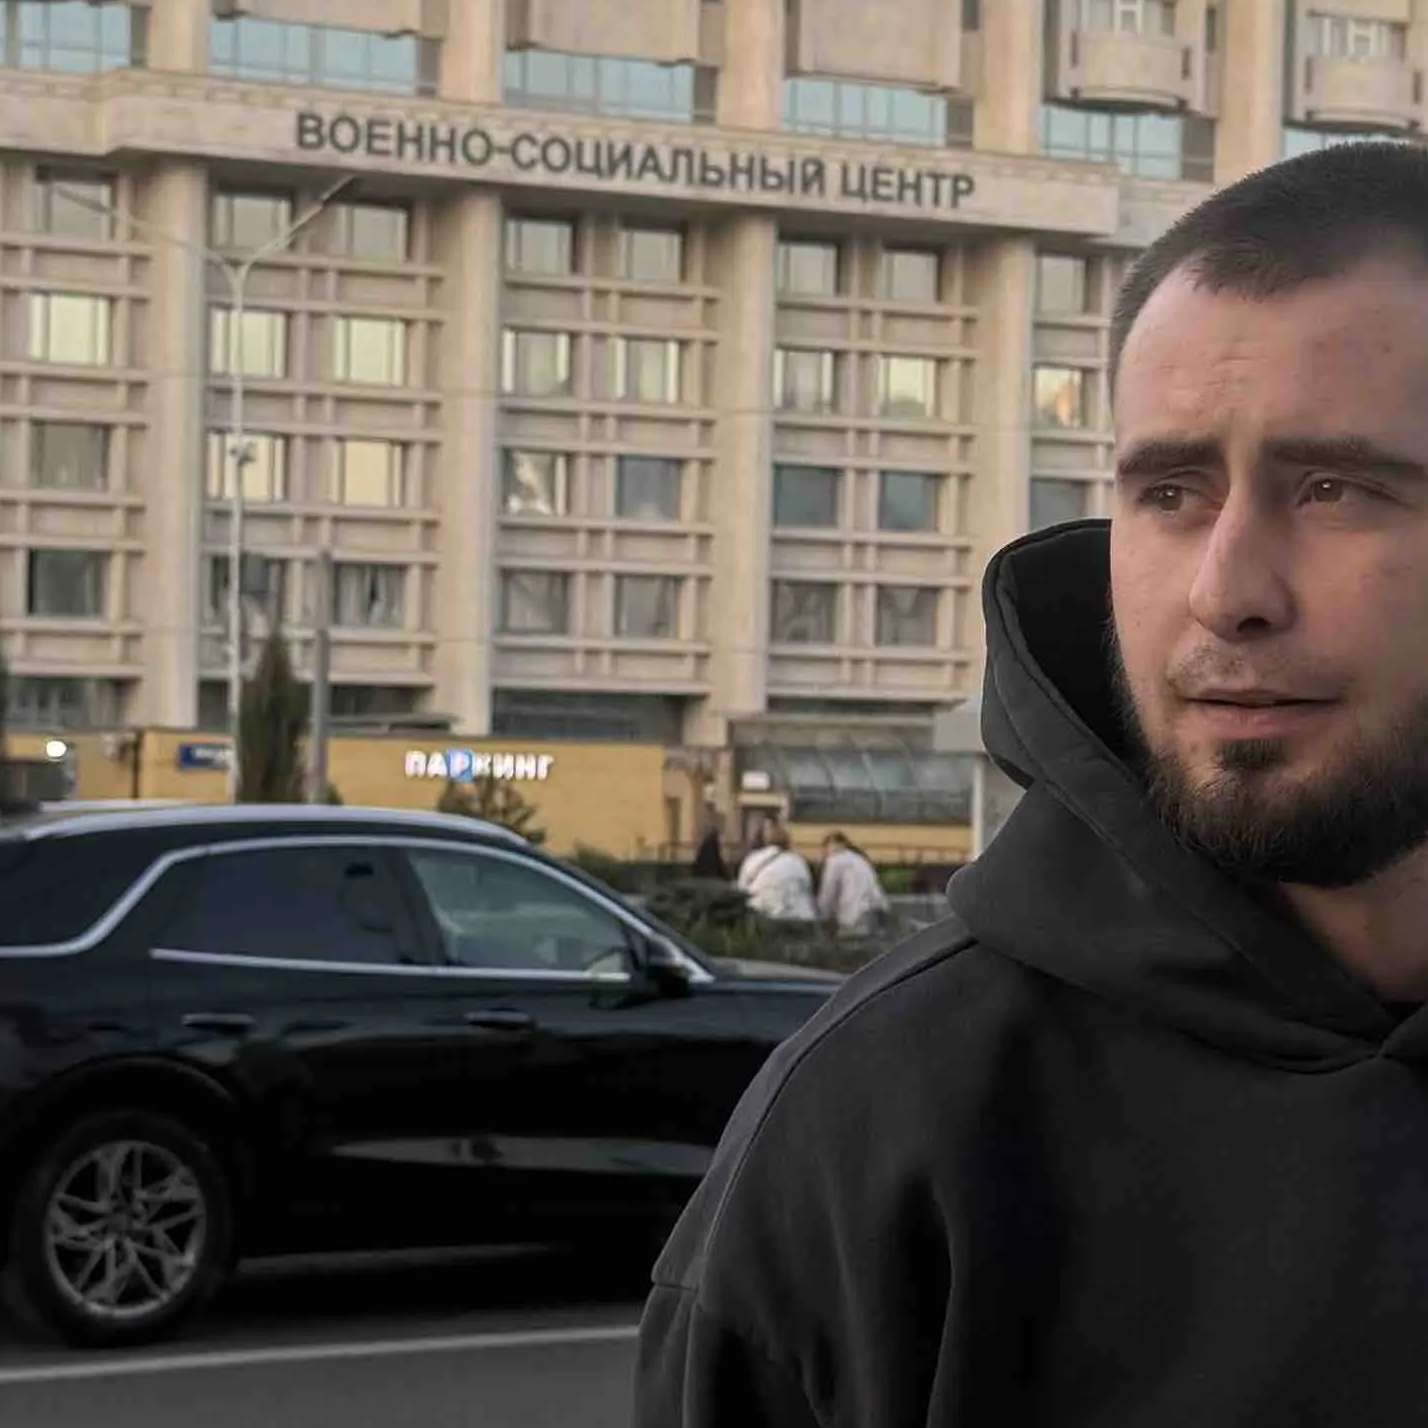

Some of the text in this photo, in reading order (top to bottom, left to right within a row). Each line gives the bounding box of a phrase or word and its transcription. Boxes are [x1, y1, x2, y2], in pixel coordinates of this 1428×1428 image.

[296, 112, 975, 209] ВОЕННО-СОЦИАЛЬНЫЙ ЦЕНТР
[405, 749, 554, 781] ПАРКИНГ
